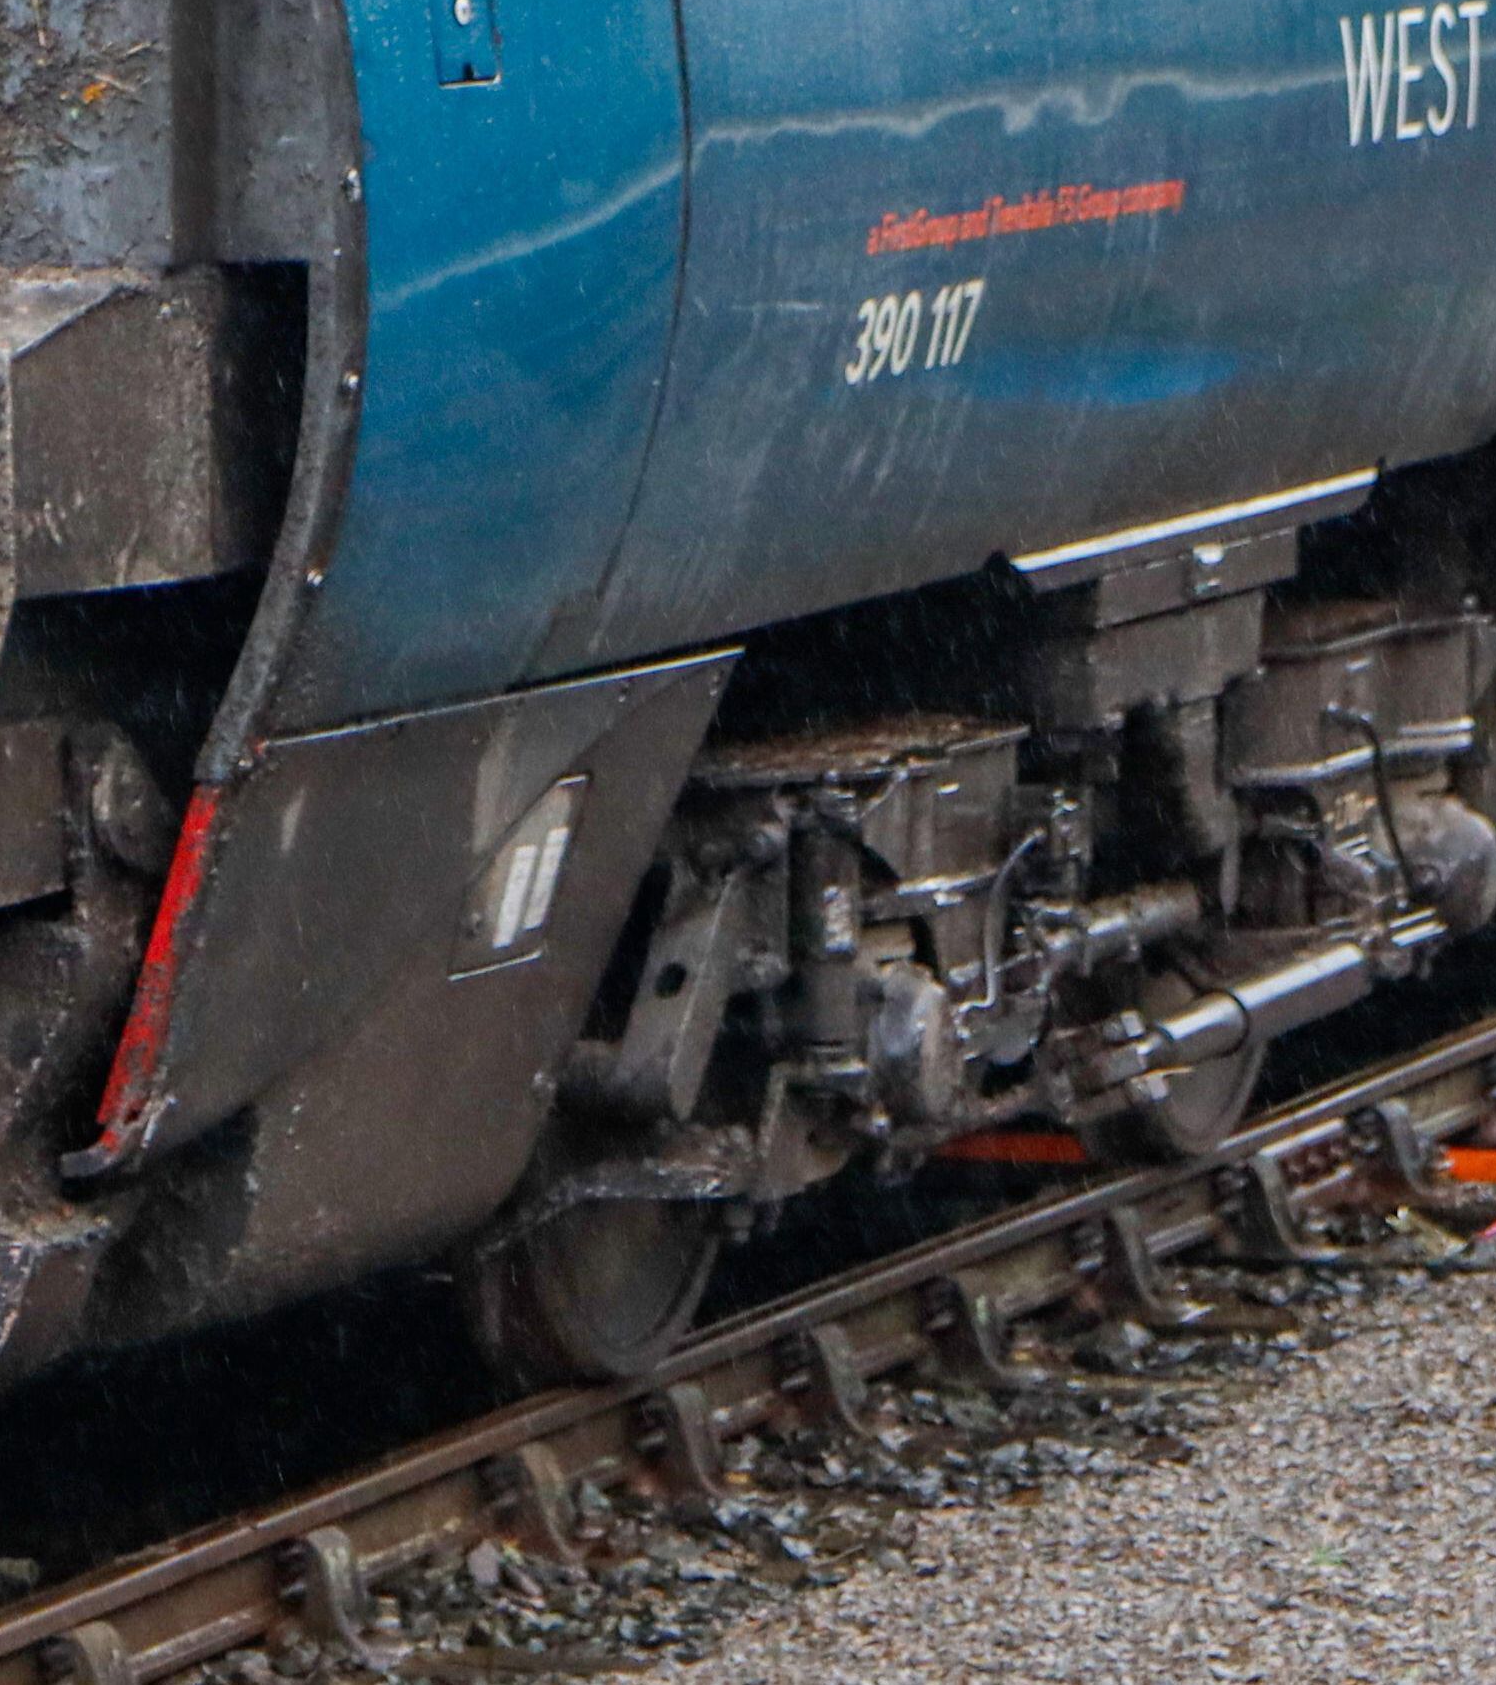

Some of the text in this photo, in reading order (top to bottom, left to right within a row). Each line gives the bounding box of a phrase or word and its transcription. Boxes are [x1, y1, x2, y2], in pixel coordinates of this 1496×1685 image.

[1340, 0, 1488, 147] WEST
[845, 278, 985, 385] 390 117
